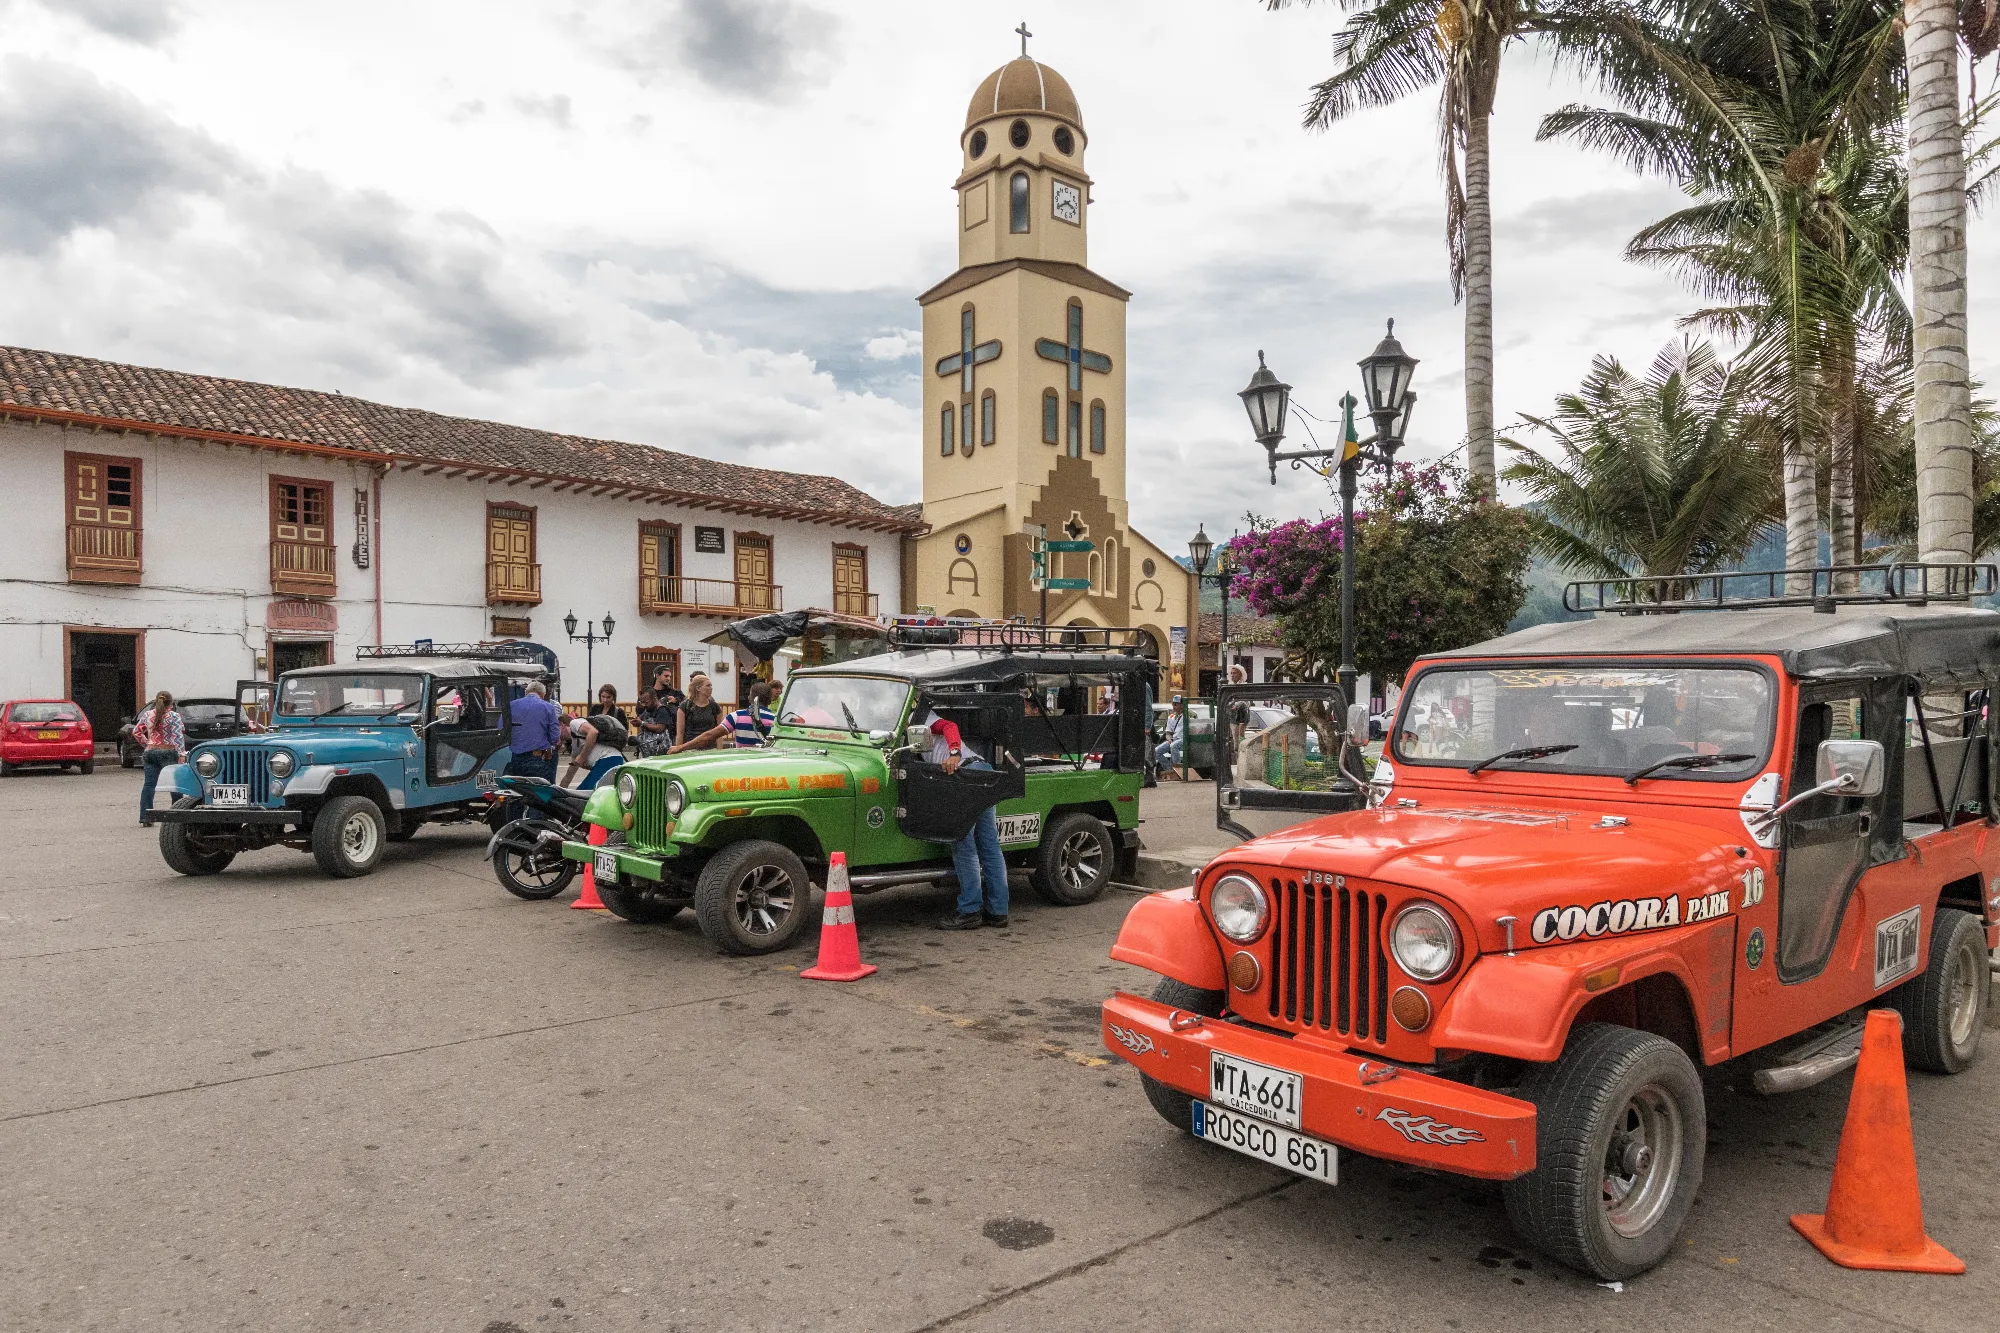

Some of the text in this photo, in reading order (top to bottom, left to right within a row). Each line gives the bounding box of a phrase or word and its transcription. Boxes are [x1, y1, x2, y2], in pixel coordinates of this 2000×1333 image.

[231, 788, 247, 800] 841
[713, 773, 847, 794] COCORA PARK
[1019, 818, 1040, 835] 522
[1301, 870, 1346, 890] Jeep
[1740, 866, 1765, 909] 16
[1531, 890, 1731, 944] COCORA PARK
[1213, 1060, 1297, 1115] WTA 661
[1230, 1097, 1278, 1121] CAICEDONIA
[1287, 1137, 1329, 1178] 661
